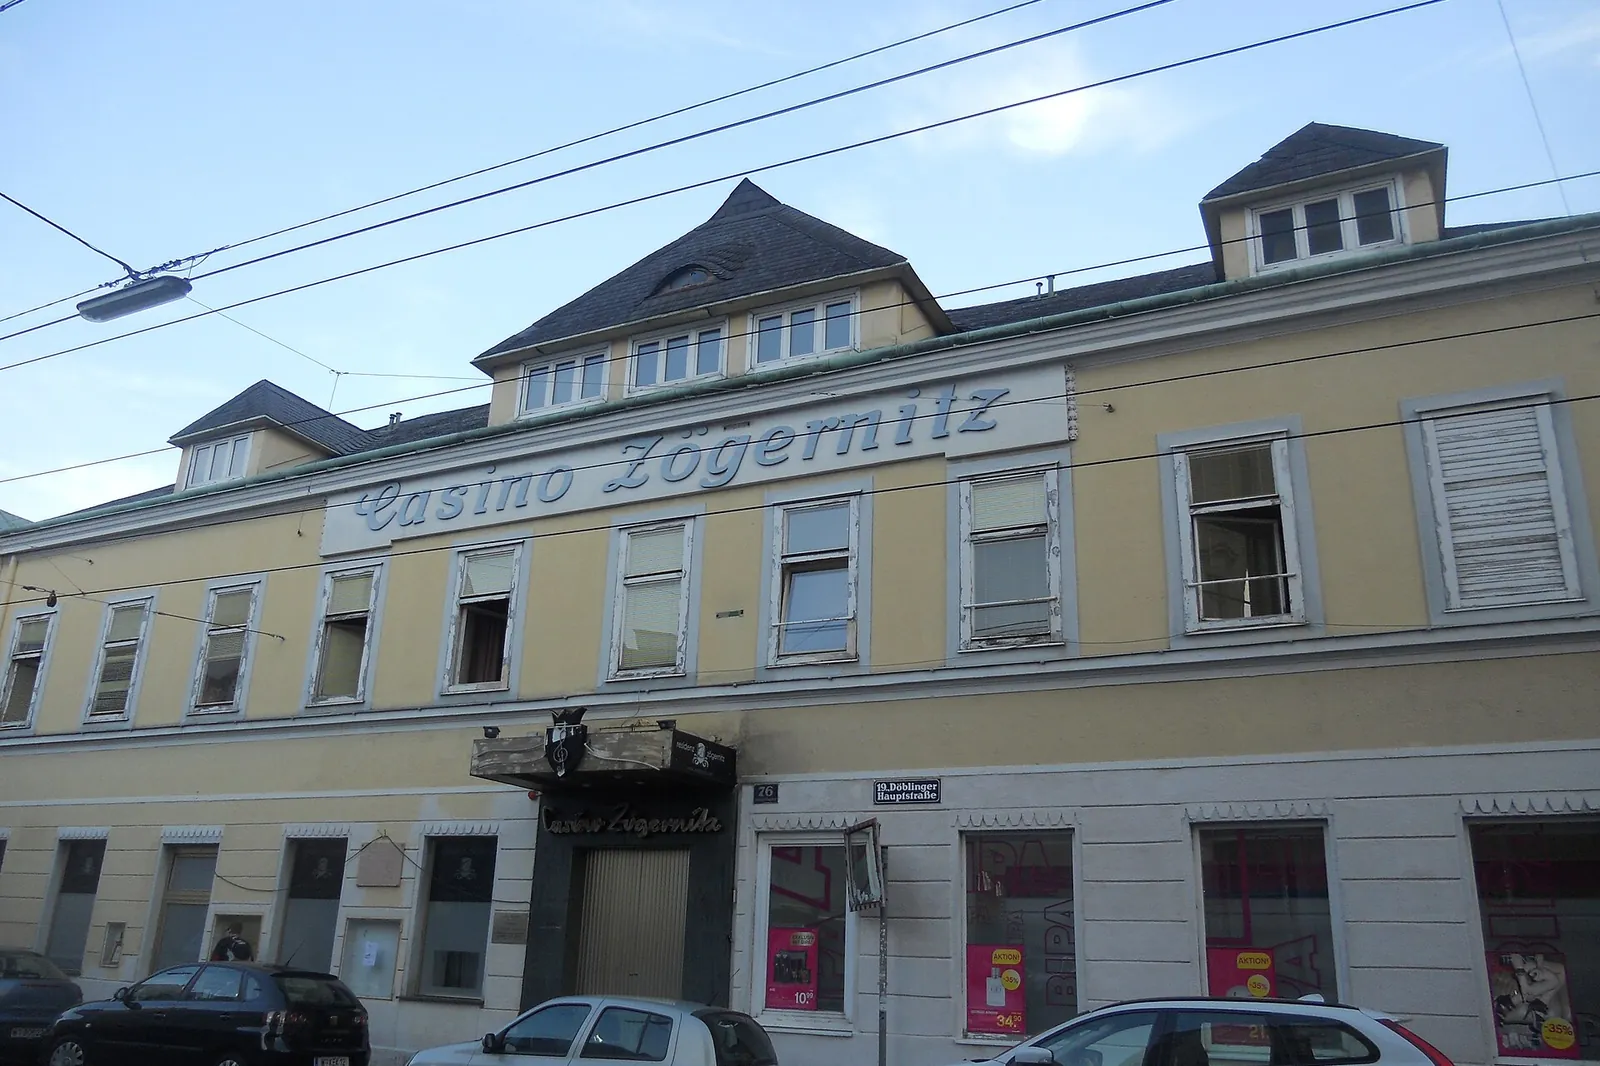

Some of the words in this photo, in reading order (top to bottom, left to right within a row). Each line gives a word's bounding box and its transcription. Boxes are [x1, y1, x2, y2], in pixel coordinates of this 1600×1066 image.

[356, 465, 574, 531] Casino
[602, 383, 1012, 493] Zögernitz
[758, 786, 774, 799] 76
[876, 789, 938, 803] Hauptstraße
[993, 952, 1020, 961] AKTION!
[1238, 956, 1270, 966] AKTION!
